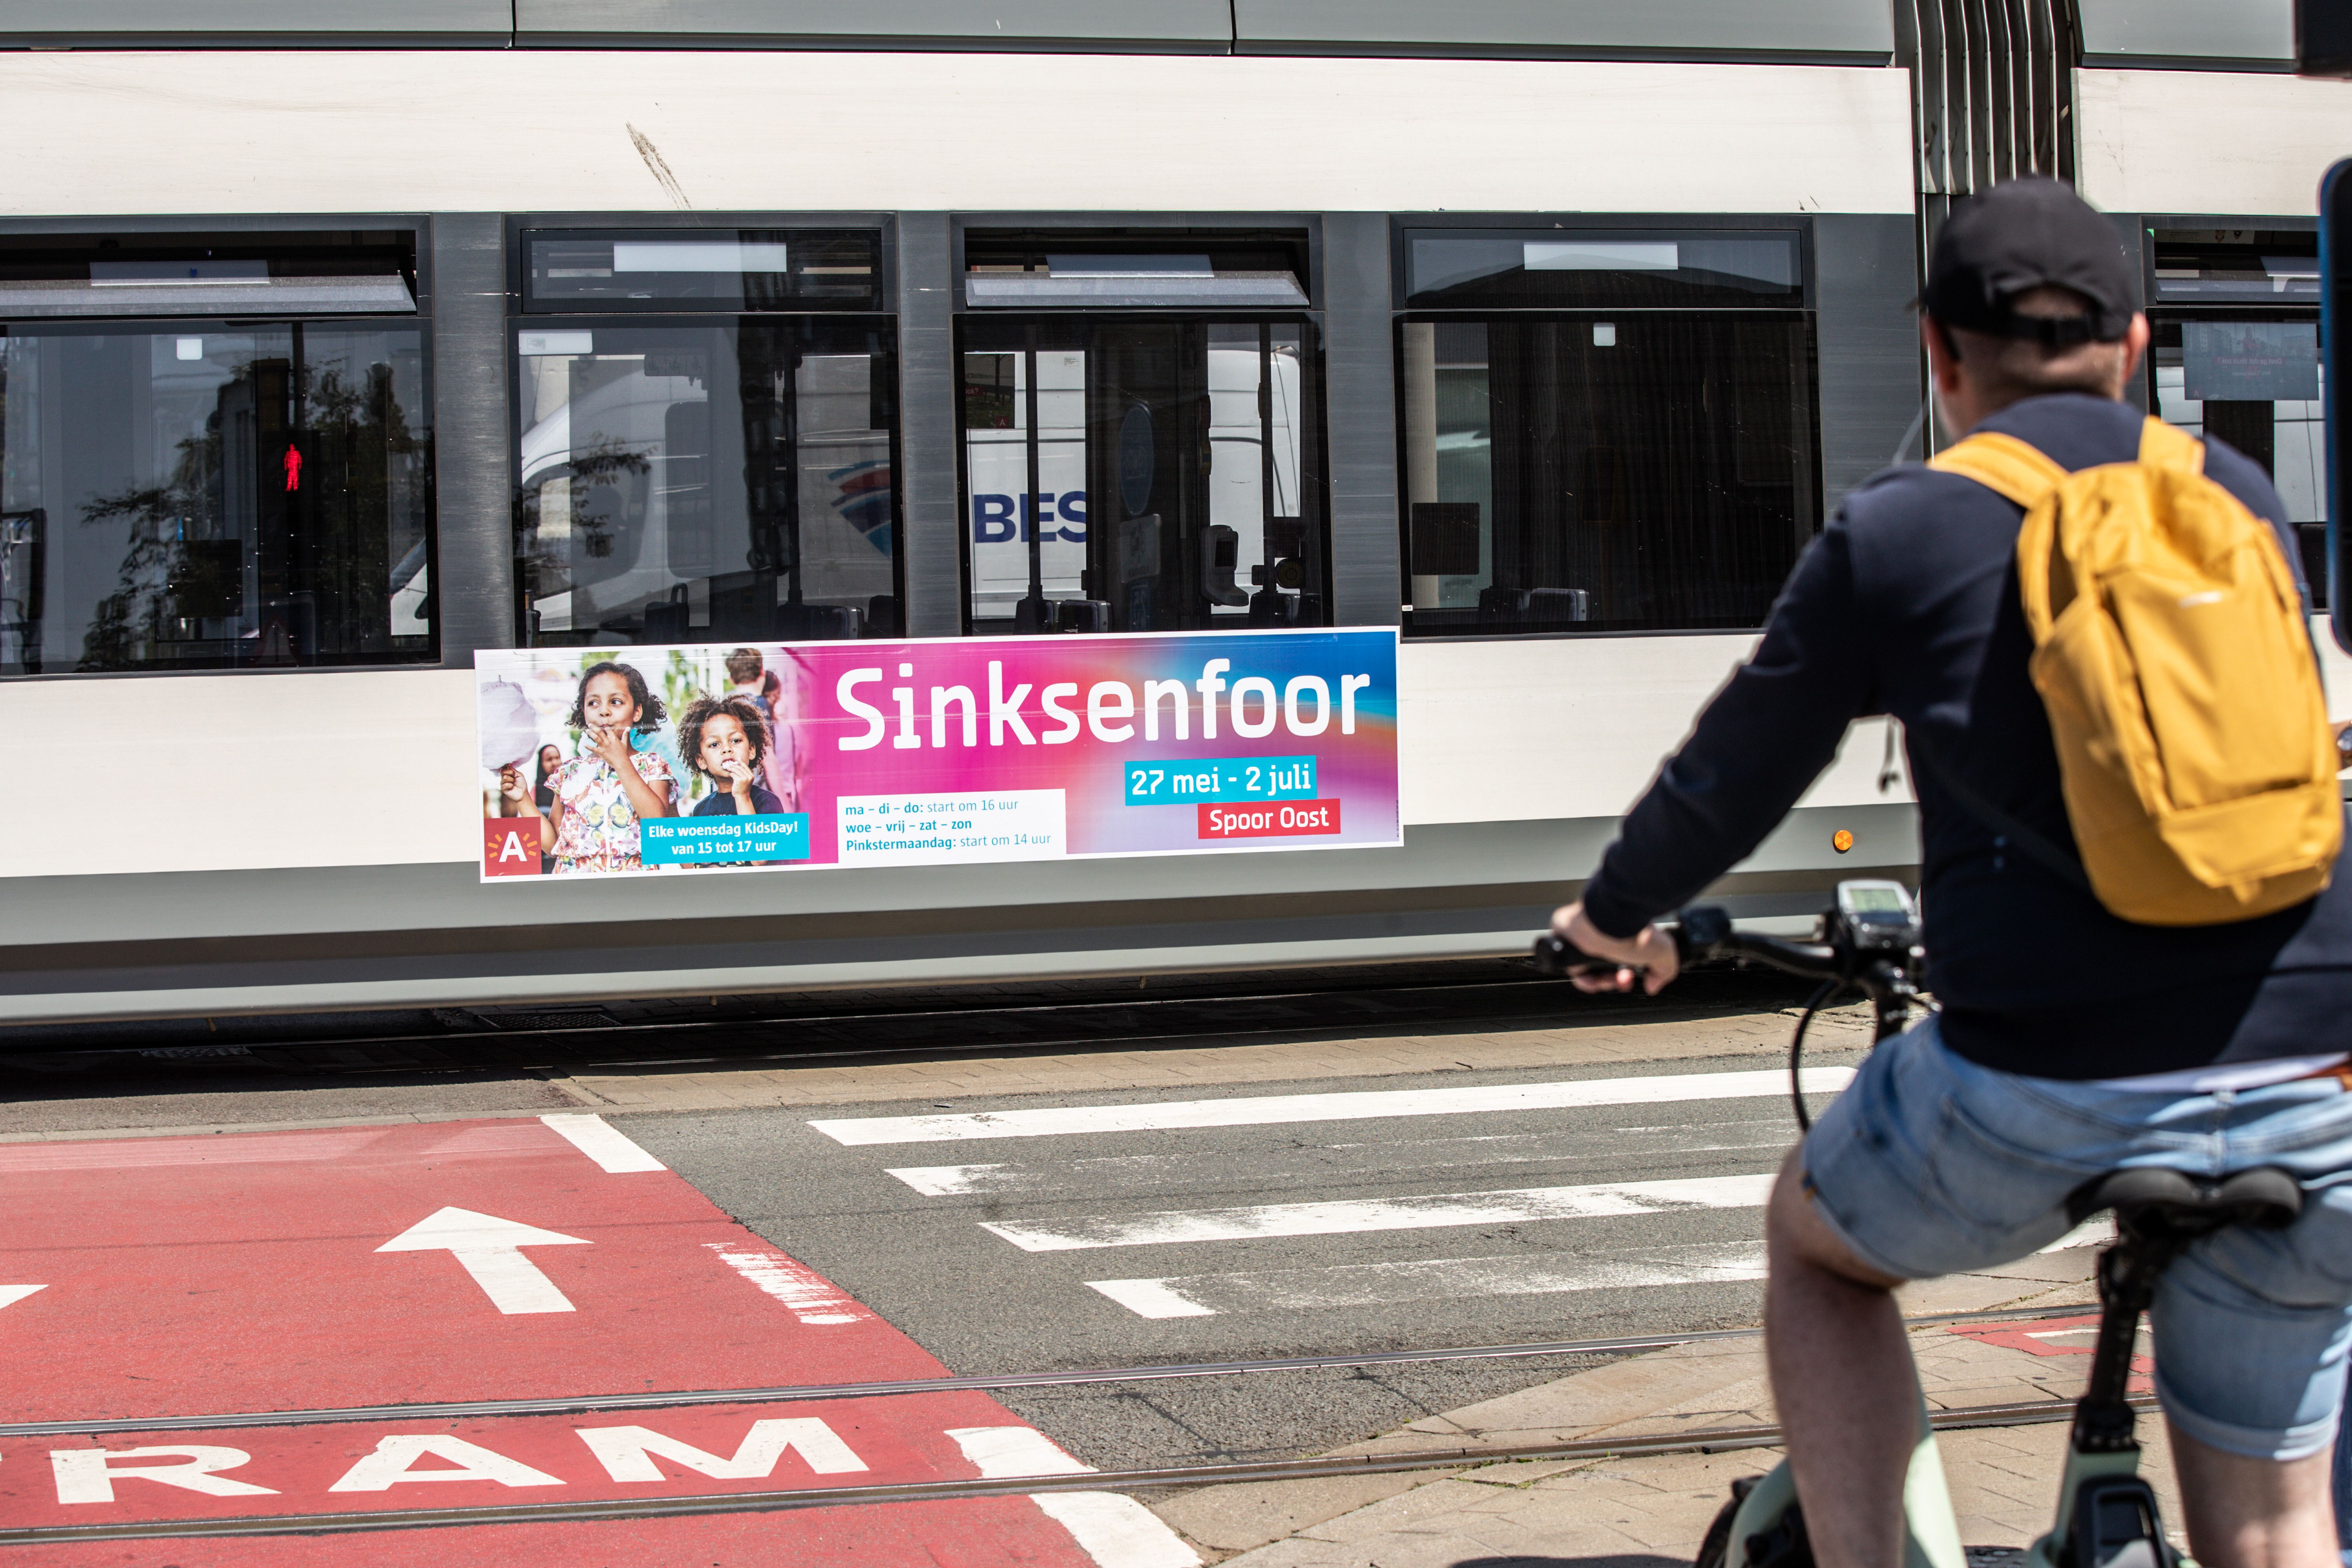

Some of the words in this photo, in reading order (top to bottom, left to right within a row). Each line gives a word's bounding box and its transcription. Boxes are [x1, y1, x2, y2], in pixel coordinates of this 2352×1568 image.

[836, 658, 1371, 752] Sinksenfoor
[1131, 769, 1164, 795] 27
[1173, 766, 1220, 794] mei
[1245, 766, 1261, 791] 2
[1267, 763, 1311, 797] juli
[846, 806, 864, 815] ma
[878, 803, 889, 814] di
[904, 802, 924, 813] do:
[927, 801, 955, 813] start
[958, 802, 977, 811] om
[981, 799, 995, 811] 16
[999, 800, 1018, 810] uur
[649, 825, 674, 838] Elke
[677, 823, 741, 837] woensdag
[745, 821, 798, 835] KidsDay!
[846, 823, 871, 833] woe
[886, 820, 905, 834] vrij
[919, 820, 937, 831] zat
[951, 819, 972, 830] zon
[1210, 809, 1274, 835] Spoor
[1279, 806, 1329, 828] Oost
[499, 831, 528, 863] A
[671, 844, 694, 855] van
[697, 842, 713, 854] 15
[715, 841, 734, 853] tot
[737, 840, 752, 852] 17
[755, 842, 777, 852] uur
[846, 837, 957, 851] Pinkstermaandag:
[960, 835, 988, 848] start
[991, 837, 1009, 846] om
[1014, 833, 1028, 845] 14
[1031, 834, 1051, 844] uur
[0, 1417, 870, 1505] RAM
